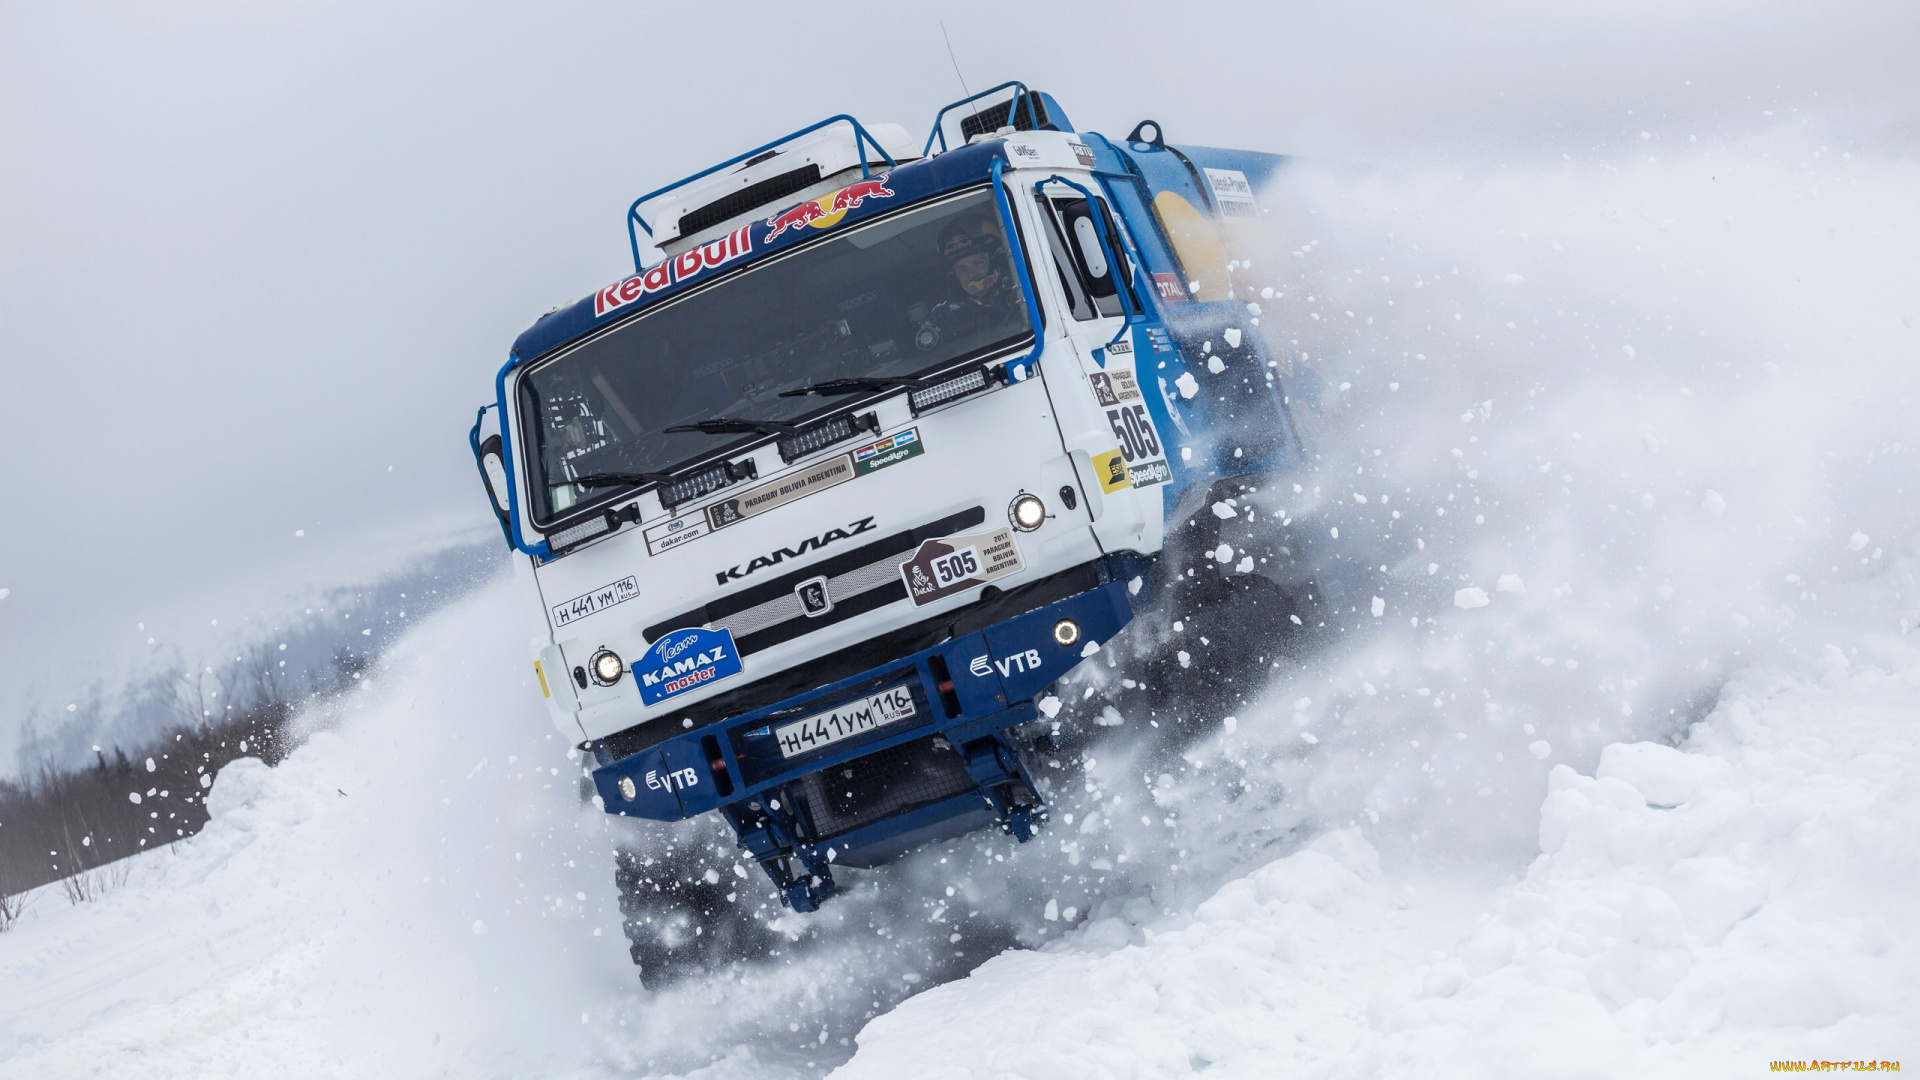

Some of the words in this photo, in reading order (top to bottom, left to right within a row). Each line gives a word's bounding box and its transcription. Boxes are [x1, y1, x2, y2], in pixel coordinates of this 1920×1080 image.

[594, 260, 671, 318] Red
[674, 223, 753, 283] Bull
[1156, 281, 1183, 298] OTAL
[1106, 404, 1160, 463] 505
[869, 448, 909, 468] SpeedAgro
[744, 489, 778, 509] PARAGUAY
[780, 479, 807, 497] BOLIVIA
[807, 464, 847, 486] ARGENTINA
[1129, 463, 1167, 487] SpeedAgro
[661, 529, 699, 548] dakar.com
[983, 541, 1012, 556] PARAGUAY
[994, 532, 1008, 543] 2017
[716, 516, 877, 586] KAMAZ
[993, 550, 1015, 563] BOLIVIA
[936, 550, 977, 583] 505
[986, 558, 1018, 575] ARGENTINA
[617, 579, 633, 593] 116
[620, 592, 632, 600] RUS
[656, 633, 698, 663] Team
[642, 646, 727, 687] KAMAZ
[995, 648, 1042, 678] VTB
[666, 666, 716, 694] master
[872, 690, 907, 716] 116
[884, 710, 901, 721] RUS
[660, 767, 698, 793] VTB
